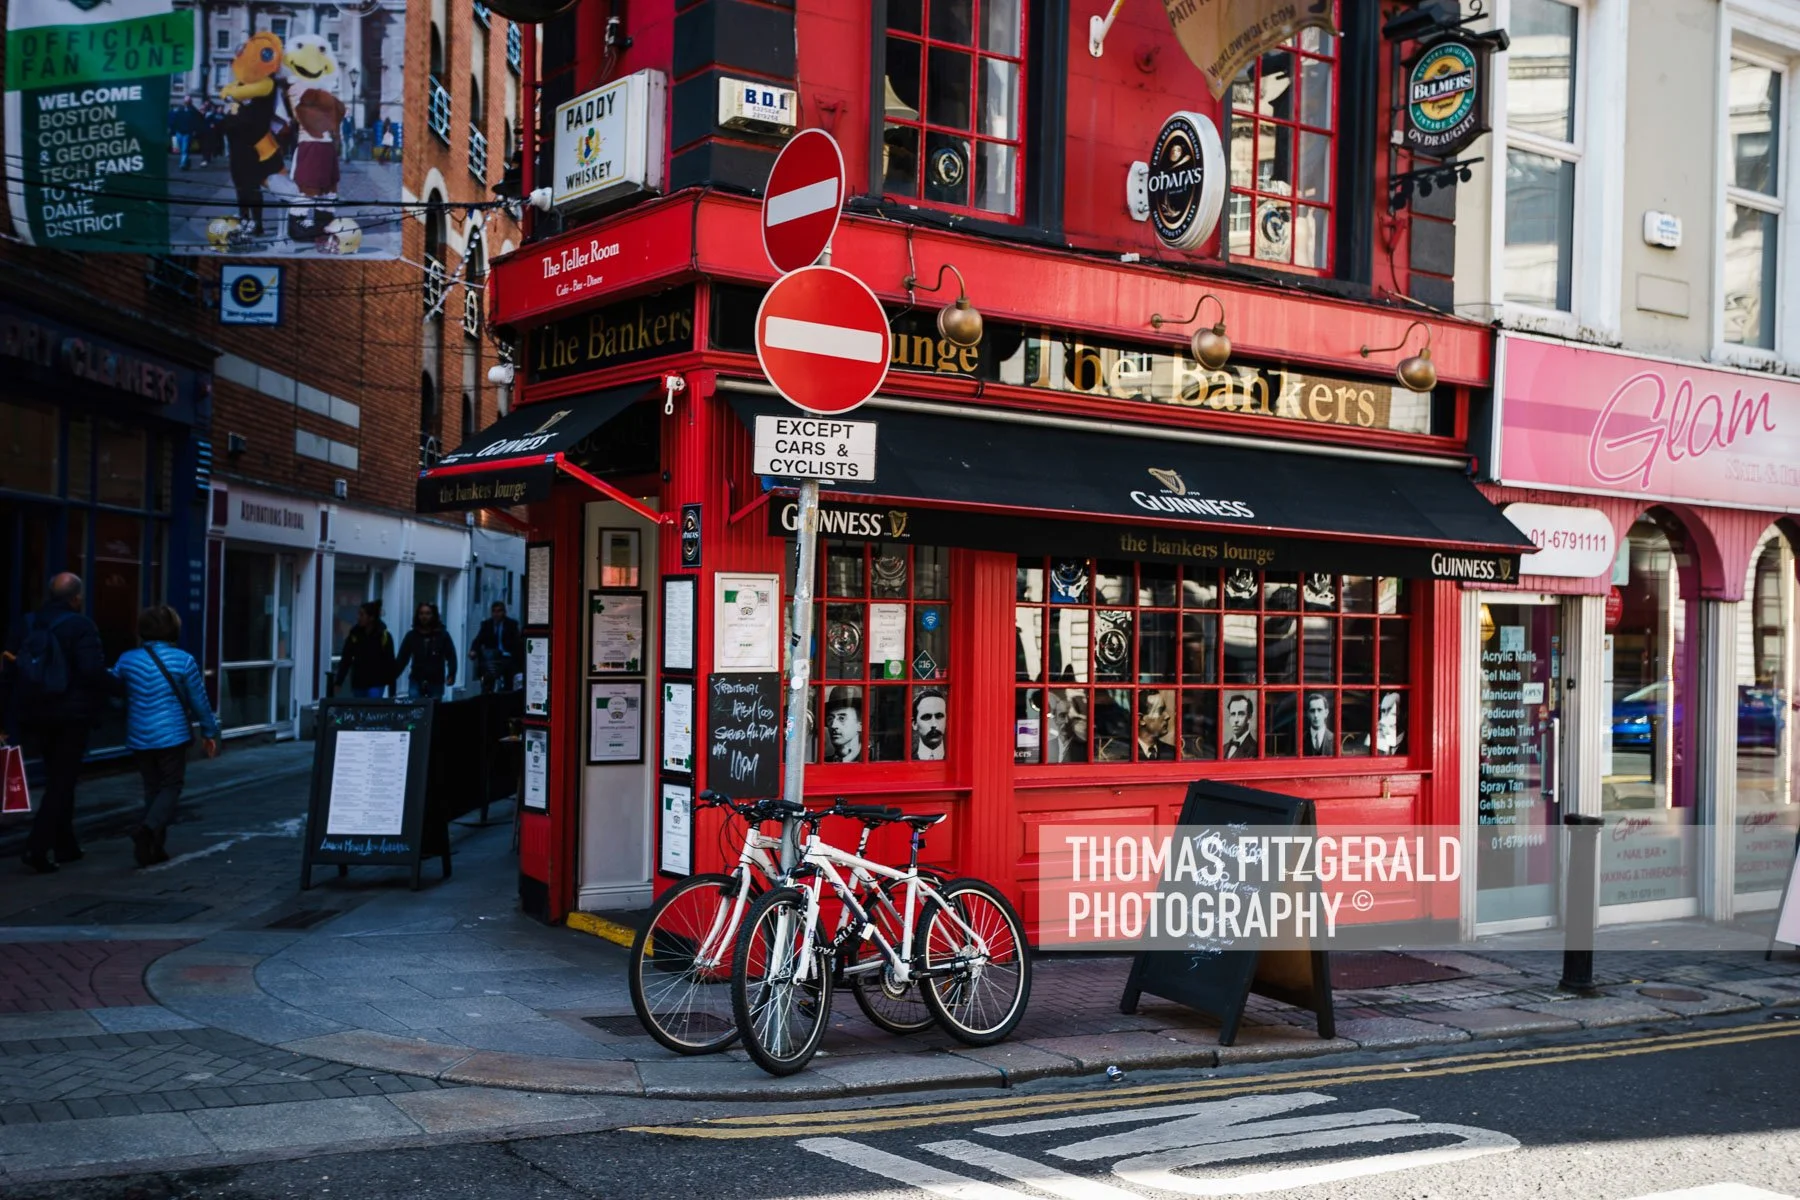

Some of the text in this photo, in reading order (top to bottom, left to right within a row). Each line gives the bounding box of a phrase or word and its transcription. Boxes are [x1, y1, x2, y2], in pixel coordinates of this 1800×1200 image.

[22, 22, 174, 57] OFFICIAL
[21, 44, 185, 81] FAN ZONE
[38, 86, 142, 110] WELCOME
[1414, 73, 1472, 100] BULMERS
[38, 105, 117, 129] BOSTON
[566, 91, 617, 132] PADDY
[38, 122, 126, 147] COLLEGE
[1408, 112, 1476, 147] ON DRAUGHT
[56, 138, 141, 163] GEORGIA
[40, 156, 144, 184] TECH FANS
[565, 160, 612, 190] WHISKEY
[42, 199, 95, 221] DAME
[45, 212, 124, 237] DISTRICT
[542, 240, 619, 279] The Teller Room
[538, 303, 692, 371] The Bankers
[891, 332, 978, 374] unge
[1170, 346, 1376, 428] Bankers
[776, 419, 854, 439] EXCEPT
[1589, 372, 1777, 490] Glam
[775, 440, 849, 457] CARS &
[769, 458, 859, 477] CYCLISTS
[456, 482, 491, 501] bankers
[495, 479, 527, 501] lounge
[1130, 490, 1255, 518] GUINNESS
[781, 503, 882, 537] GNNESS
[1120, 533, 1276, 565] the bankers lounge
[1531, 528, 1607, 552] 01-6791111
[1431, 552, 1496, 580] GUINNESS
[1482, 650, 1537, 665] Acrylic Nails
[714, 678, 759, 695] TRADITIONAL
[1482, 669, 1521, 681] Gel Nails
[1481, 688, 1523, 700] Manicure
[1481, 707, 1525, 719] Pedicures
[714, 726, 746, 741] SERVED
[760, 724, 778, 743] DAY
[1481, 725, 1535, 740] Eyelash Tint
[1014, 749, 1032, 758] kers
[1481, 742, 1538, 758] Eyebrow Tint
[1481, 763, 1525, 775] Threading
[1480, 780, 1524, 794] Spray Tan
[1480, 815, 1517, 825] Manicure
[1644, 847, 1661, 860] BAR
